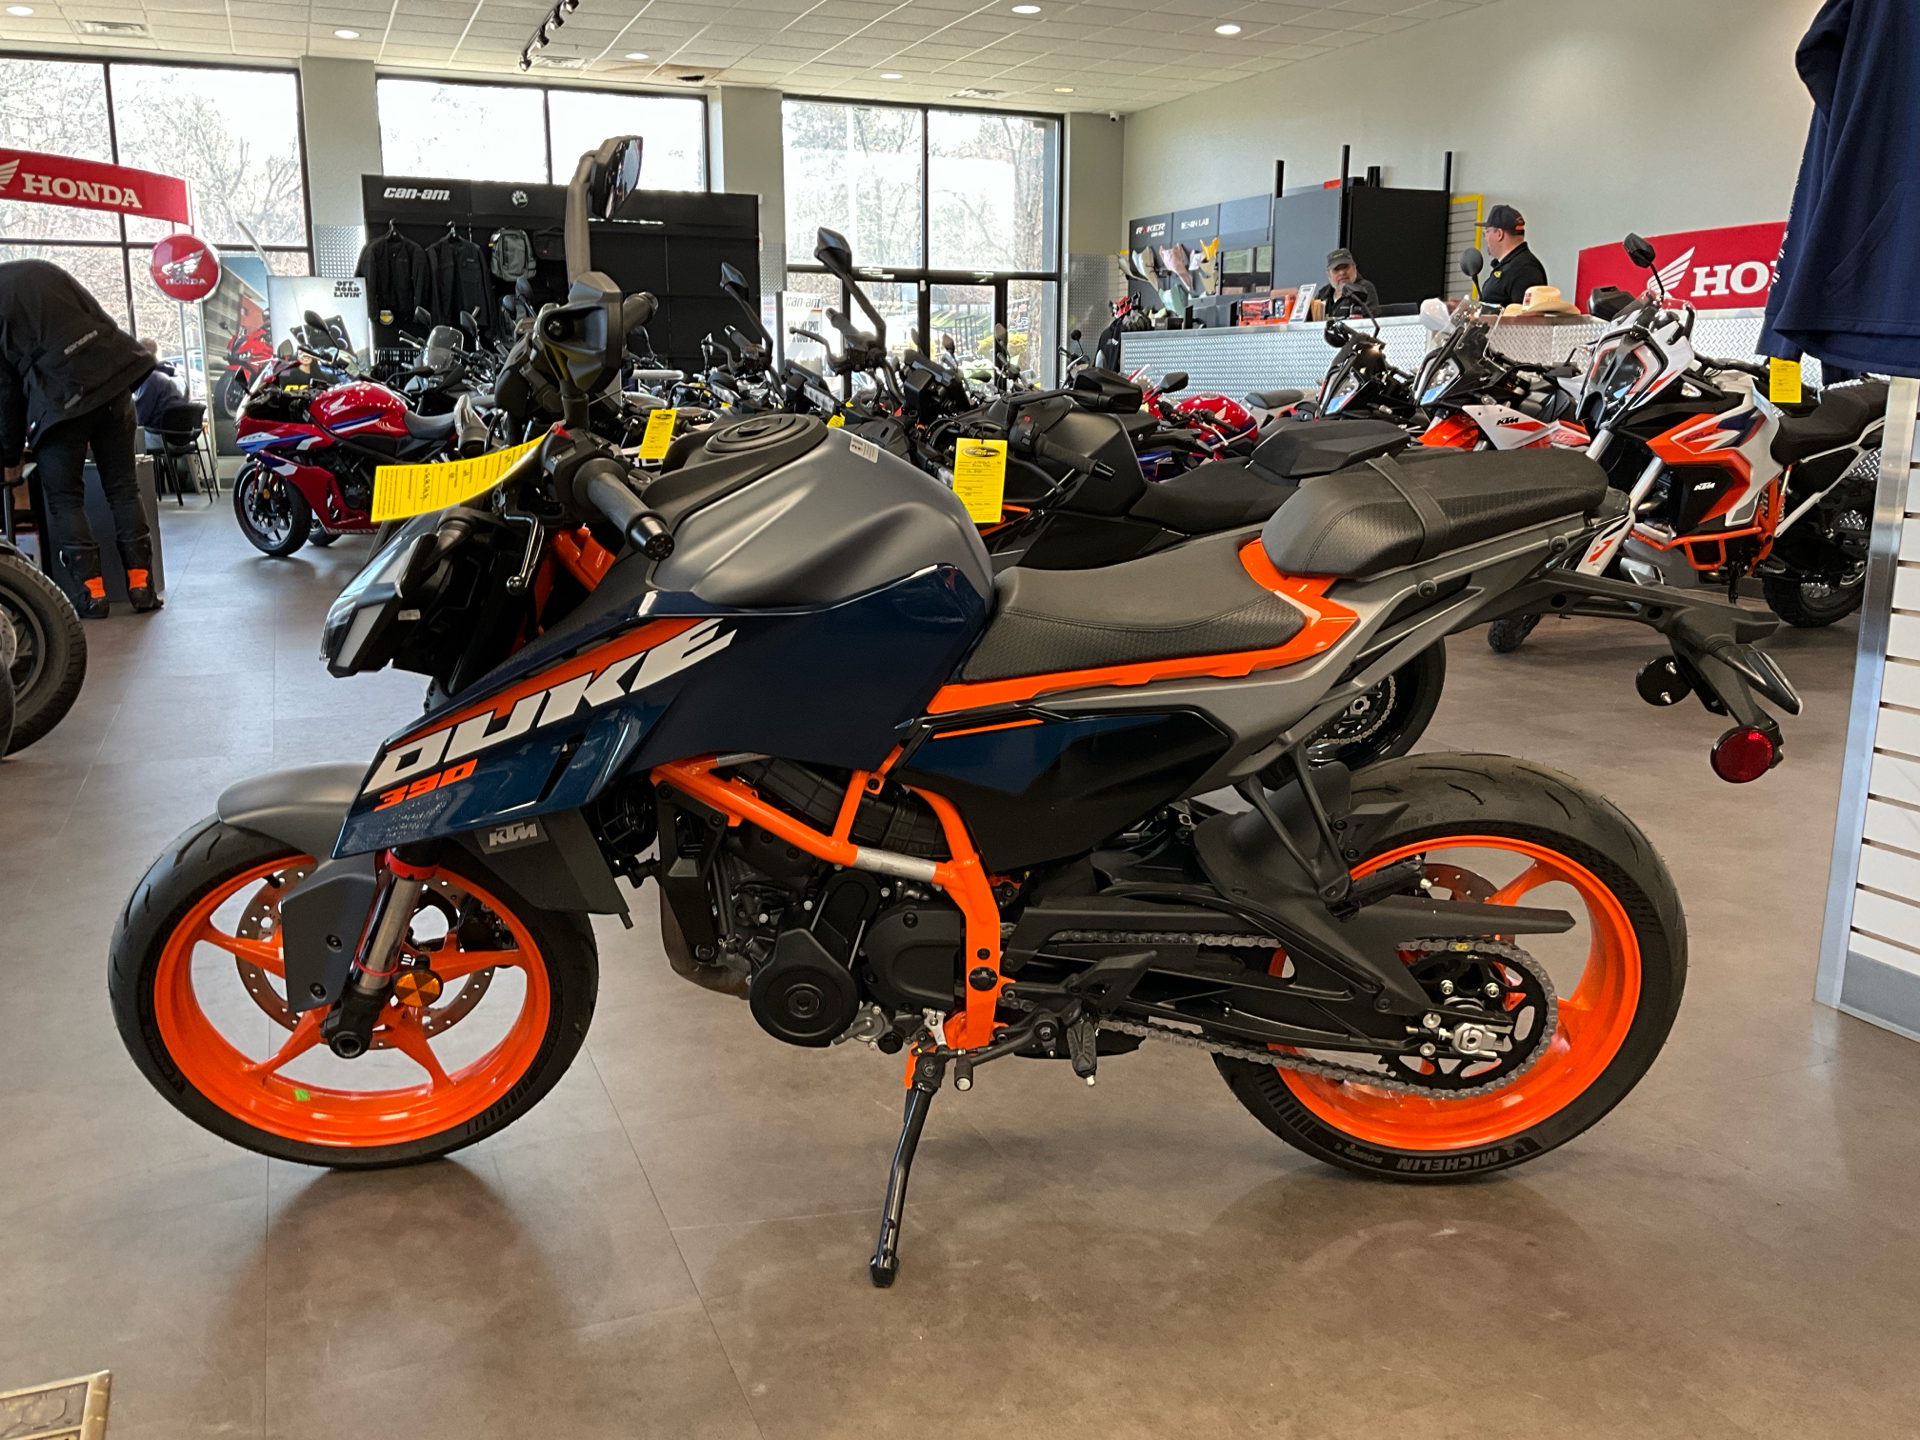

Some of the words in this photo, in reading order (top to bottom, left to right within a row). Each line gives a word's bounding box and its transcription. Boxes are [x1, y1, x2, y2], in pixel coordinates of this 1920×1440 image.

[21, 172, 142, 208] HONDA
[383, 187, 450, 201] can-am
[164, 278, 208, 286] HONDA
[1690, 260, 1778, 298] HO
[1496, 415, 1519, 426] KTM
[1693, 480, 1716, 492] KTM
[361, 618, 738, 795] DUKE
[373, 758, 478, 812] 390
[490, 823, 537, 846] KTM
[1397, 1150, 1499, 1171] MICHELIN
